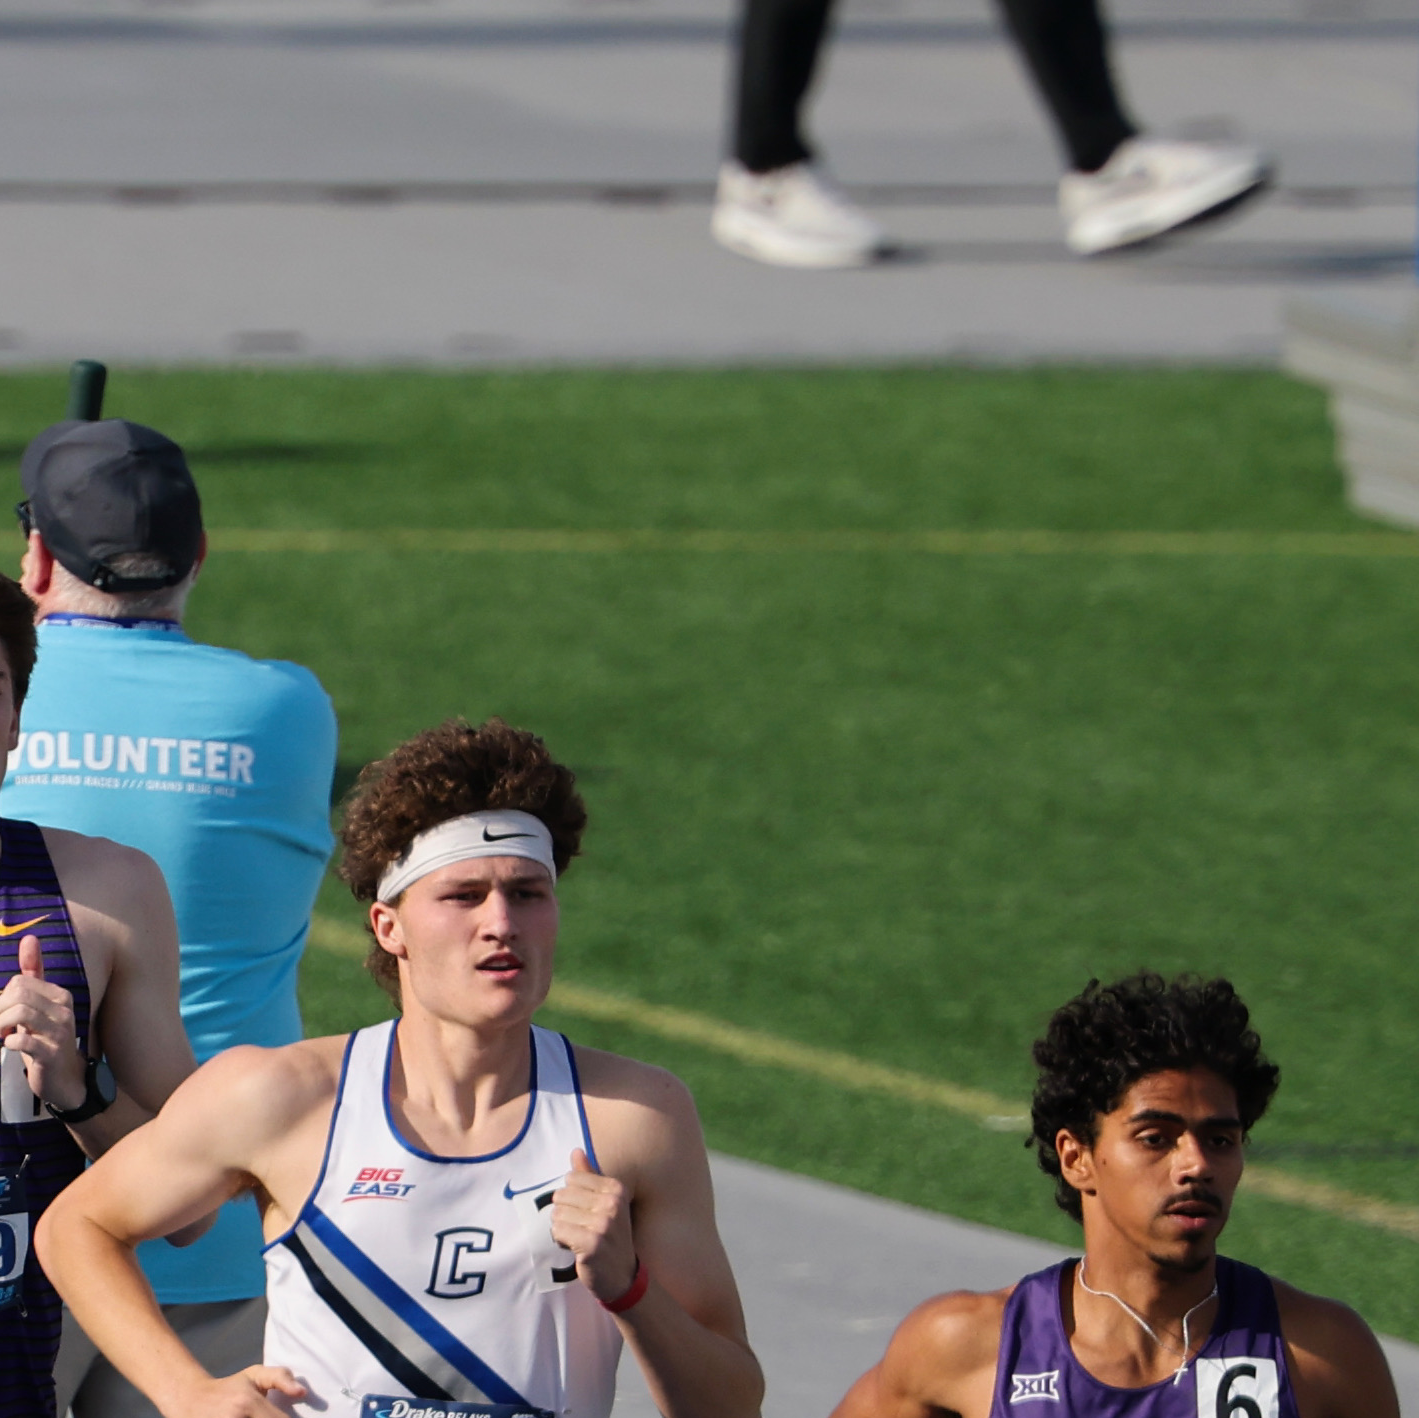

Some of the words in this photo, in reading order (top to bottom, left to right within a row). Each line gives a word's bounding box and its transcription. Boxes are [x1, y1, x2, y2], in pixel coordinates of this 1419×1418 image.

[356, 1167, 405, 1182] BIG
[347, 1182, 416, 1197] EAST
[425, 1226, 494, 1299] C
